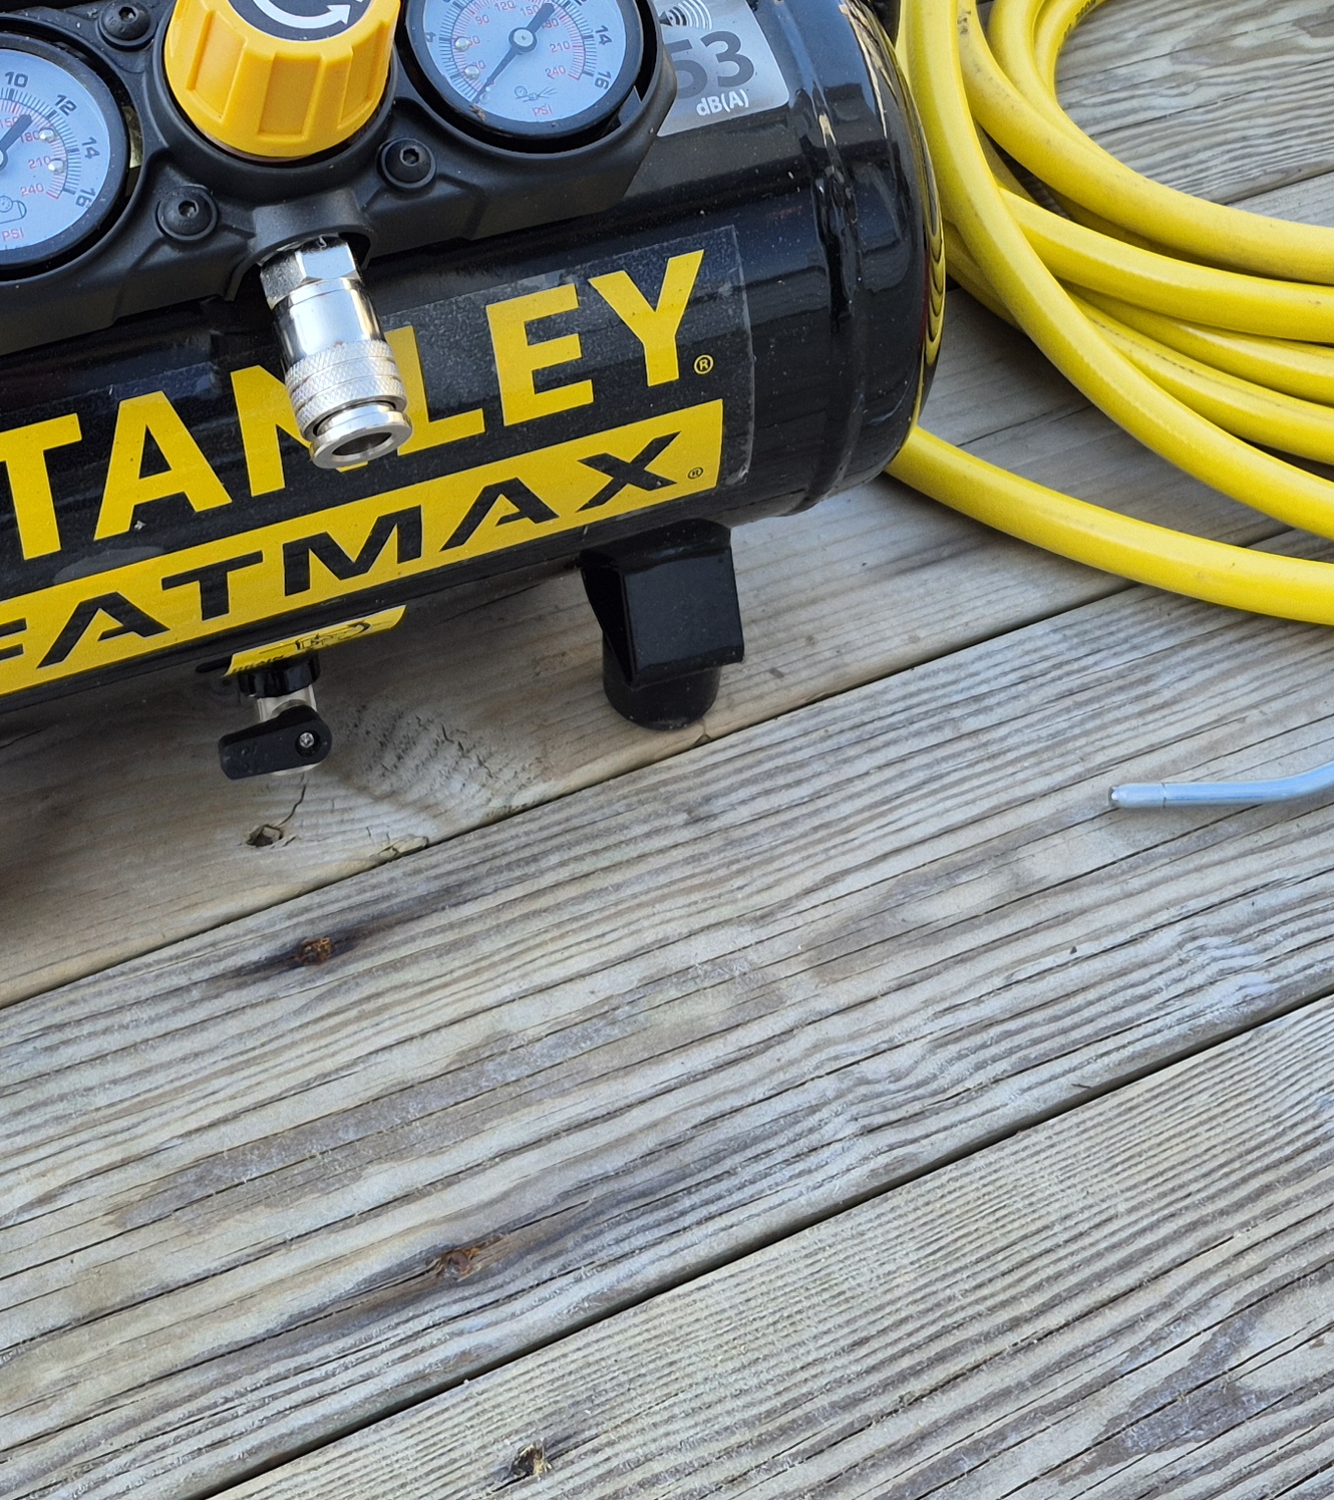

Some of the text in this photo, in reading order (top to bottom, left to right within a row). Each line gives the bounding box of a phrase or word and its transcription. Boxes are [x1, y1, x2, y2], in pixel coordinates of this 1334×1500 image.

[494, 0, 517, 12] 120
[475, 14, 490, 26] 90
[595, 25, 613, 46] 14
[549, 40, 571, 54] 210
[545, 65, 566, 80] 240
[664, 30, 754, 100] 53
[4, 71, 29, 88] 10
[594, 70, 612, 90] 16
[55, 94, 77, 117] 12
[696, 89, 749, 116] dB(A)
[81, 136, 100, 160] 14
[28, 156, 51, 170] 210
[19, 182, 45, 197] 240
[75, 187, 96, 208] 16
[1, 226, 25, 242] PSI
